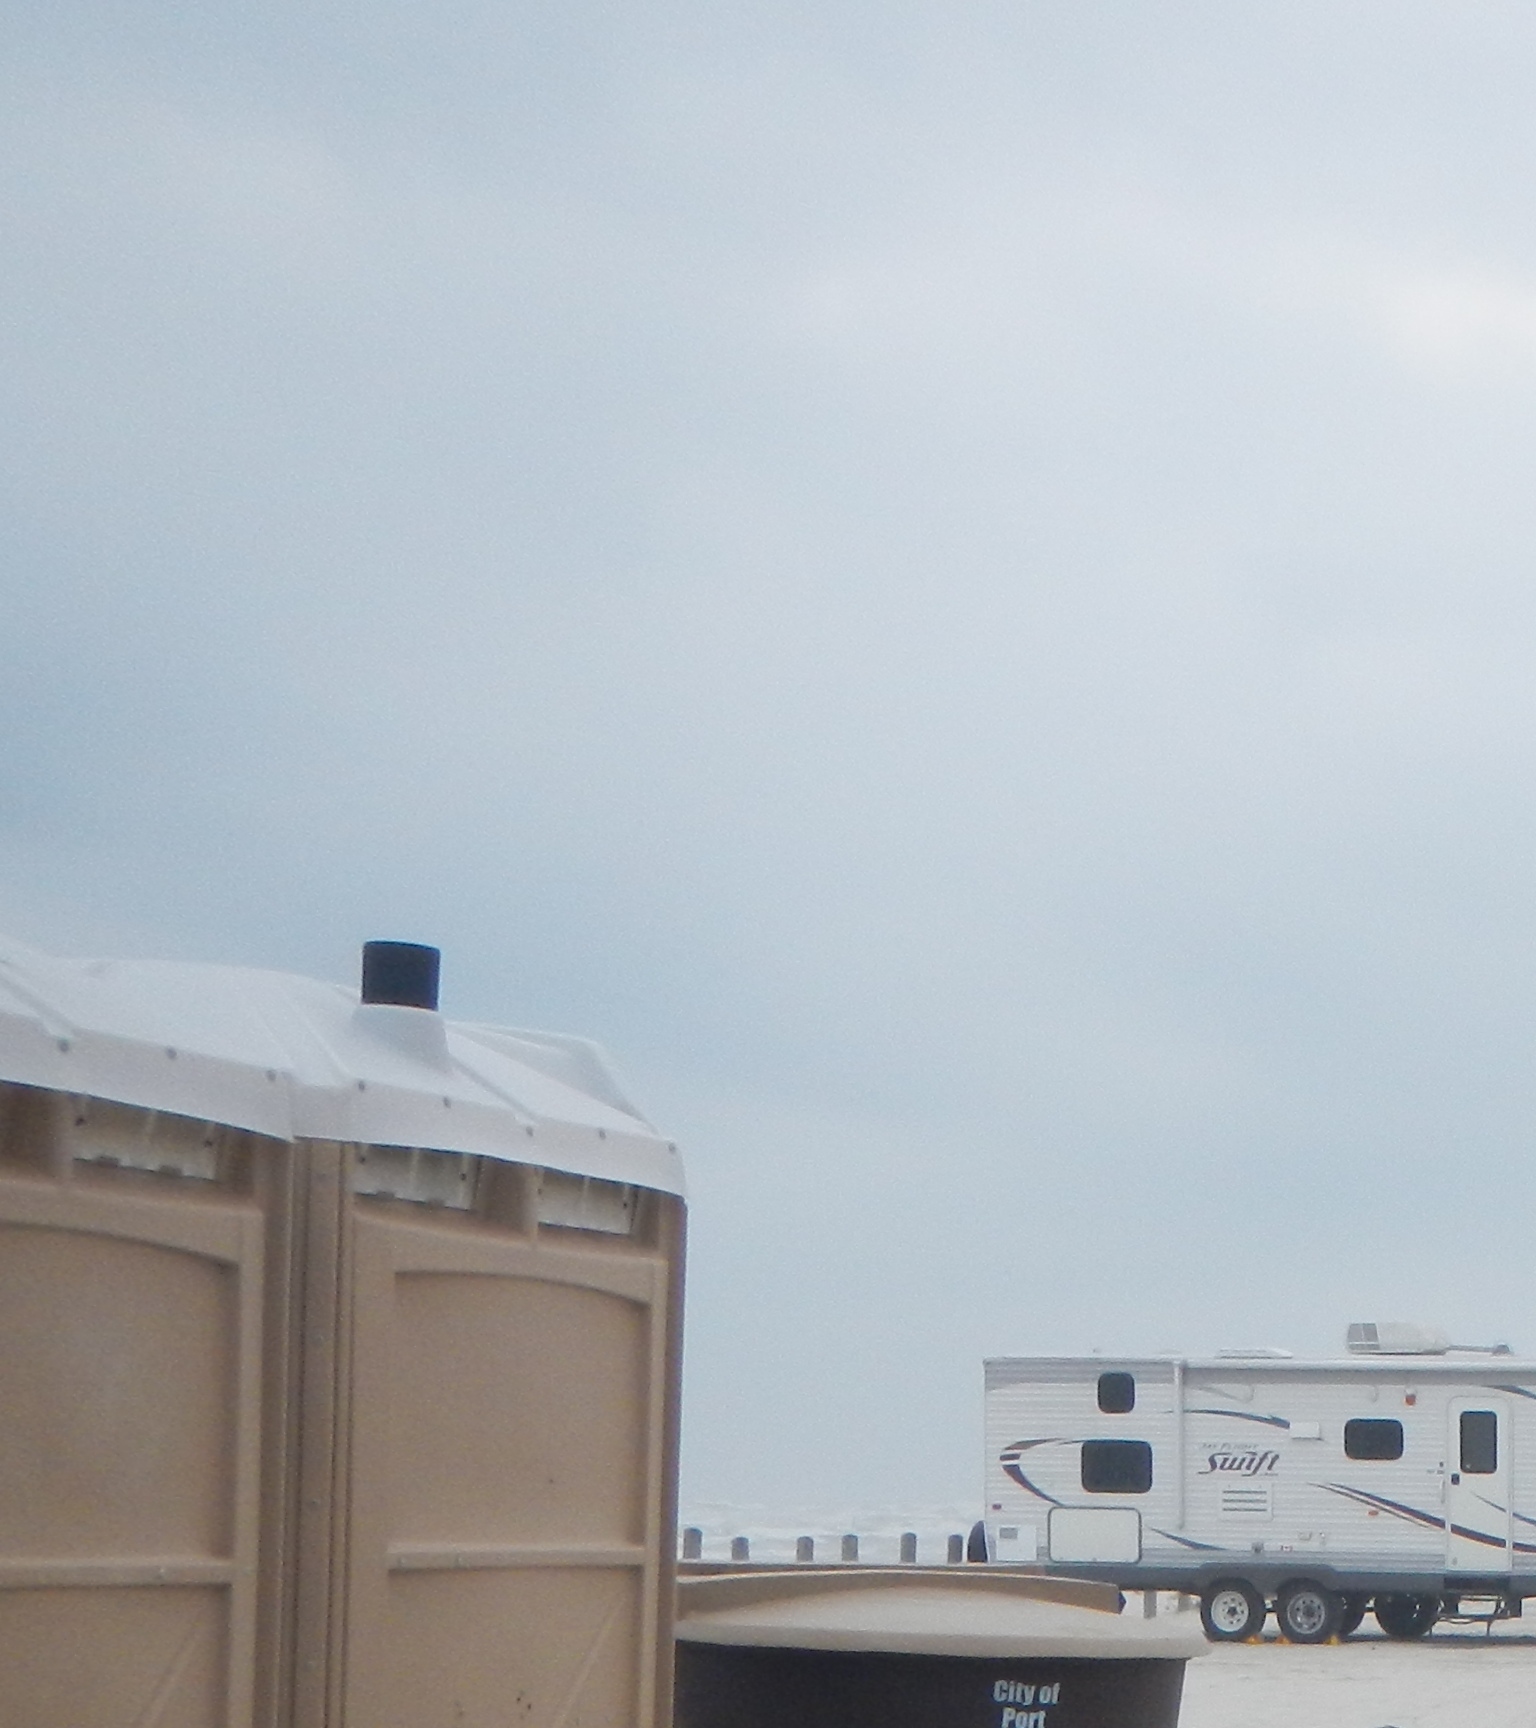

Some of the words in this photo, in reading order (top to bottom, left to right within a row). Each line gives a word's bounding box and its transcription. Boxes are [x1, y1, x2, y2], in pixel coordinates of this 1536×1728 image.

[1197, 1450, 1280, 1477] Swift
[993, 1680, 1035, 1706] City
[1039, 1681, 1061, 1705] of
